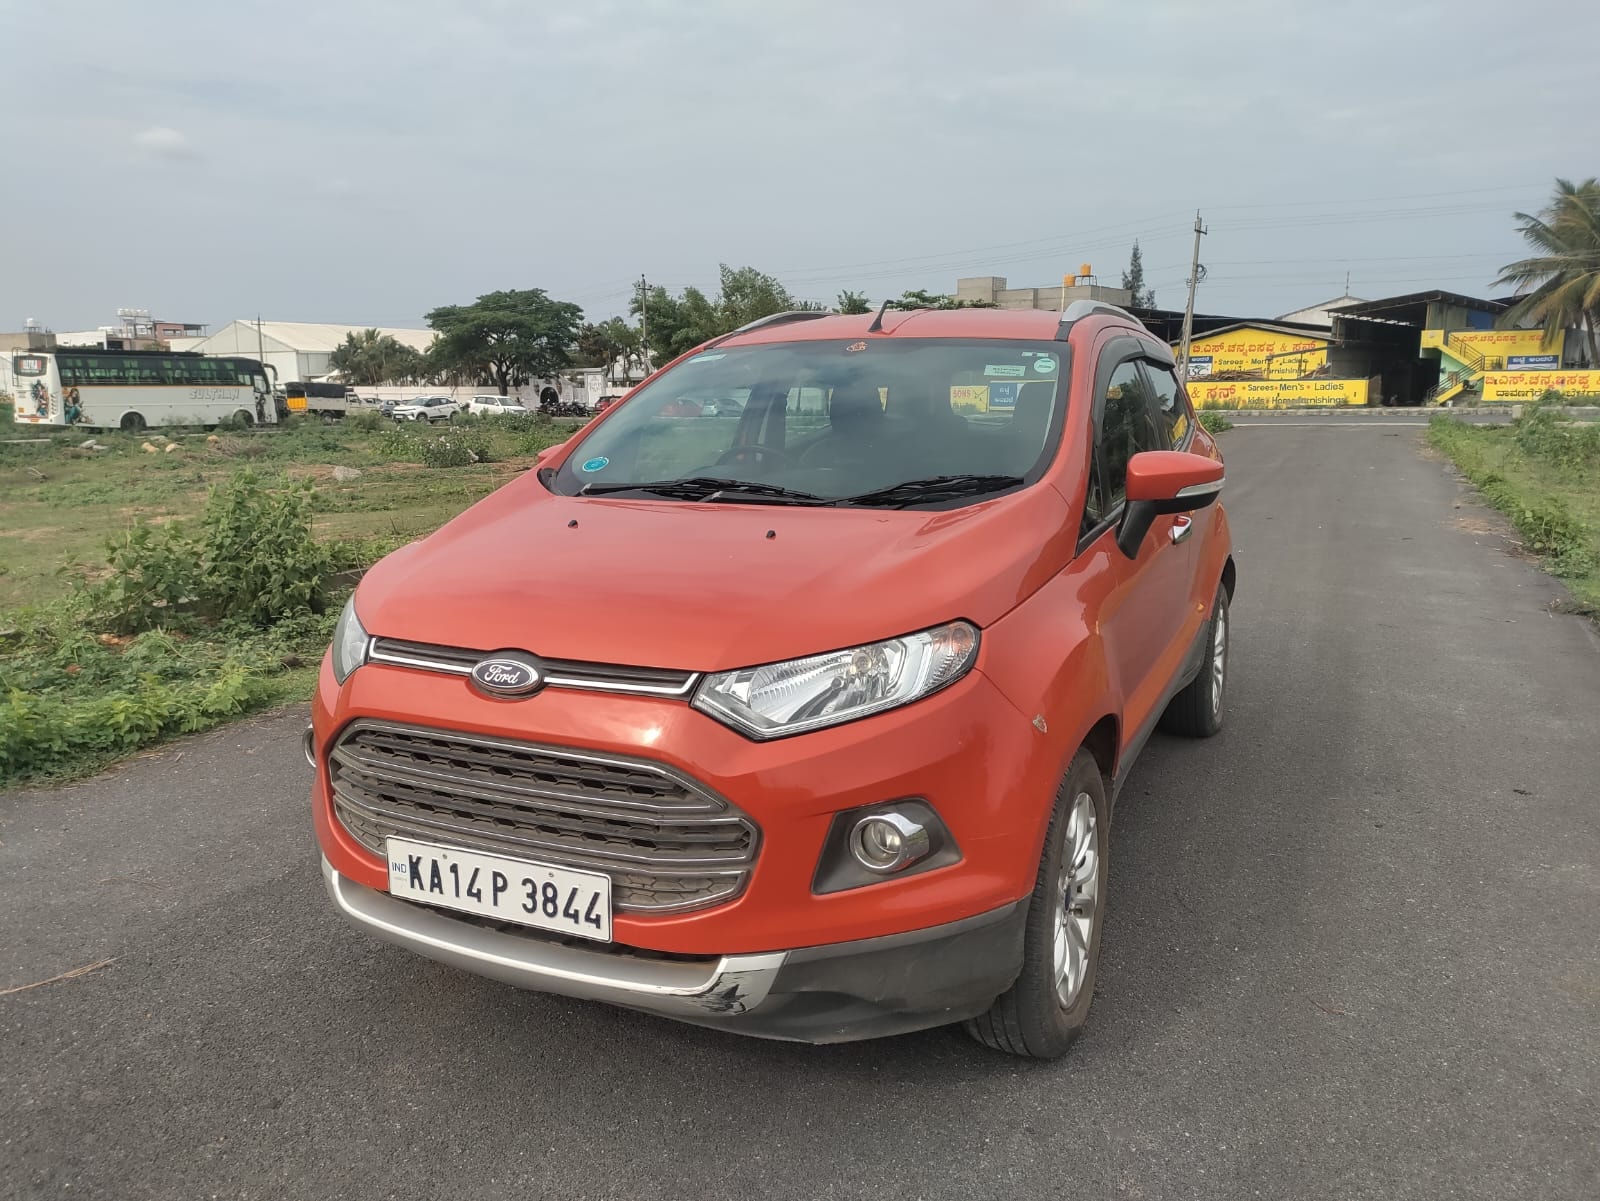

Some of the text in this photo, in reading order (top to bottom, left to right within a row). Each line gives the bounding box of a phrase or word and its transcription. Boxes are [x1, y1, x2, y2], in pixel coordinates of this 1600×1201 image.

[1280, 342, 1288, 352] &
[1191, 386, 1200, 398] &
[1248, 382, 1344, 392] Sarees Men's Ladies
[952, 389, 971, 398] SONS
[484, 664, 521, 684] Ford
[391, 861, 407, 874] IND
[521, 877, 602, 930] 3844
